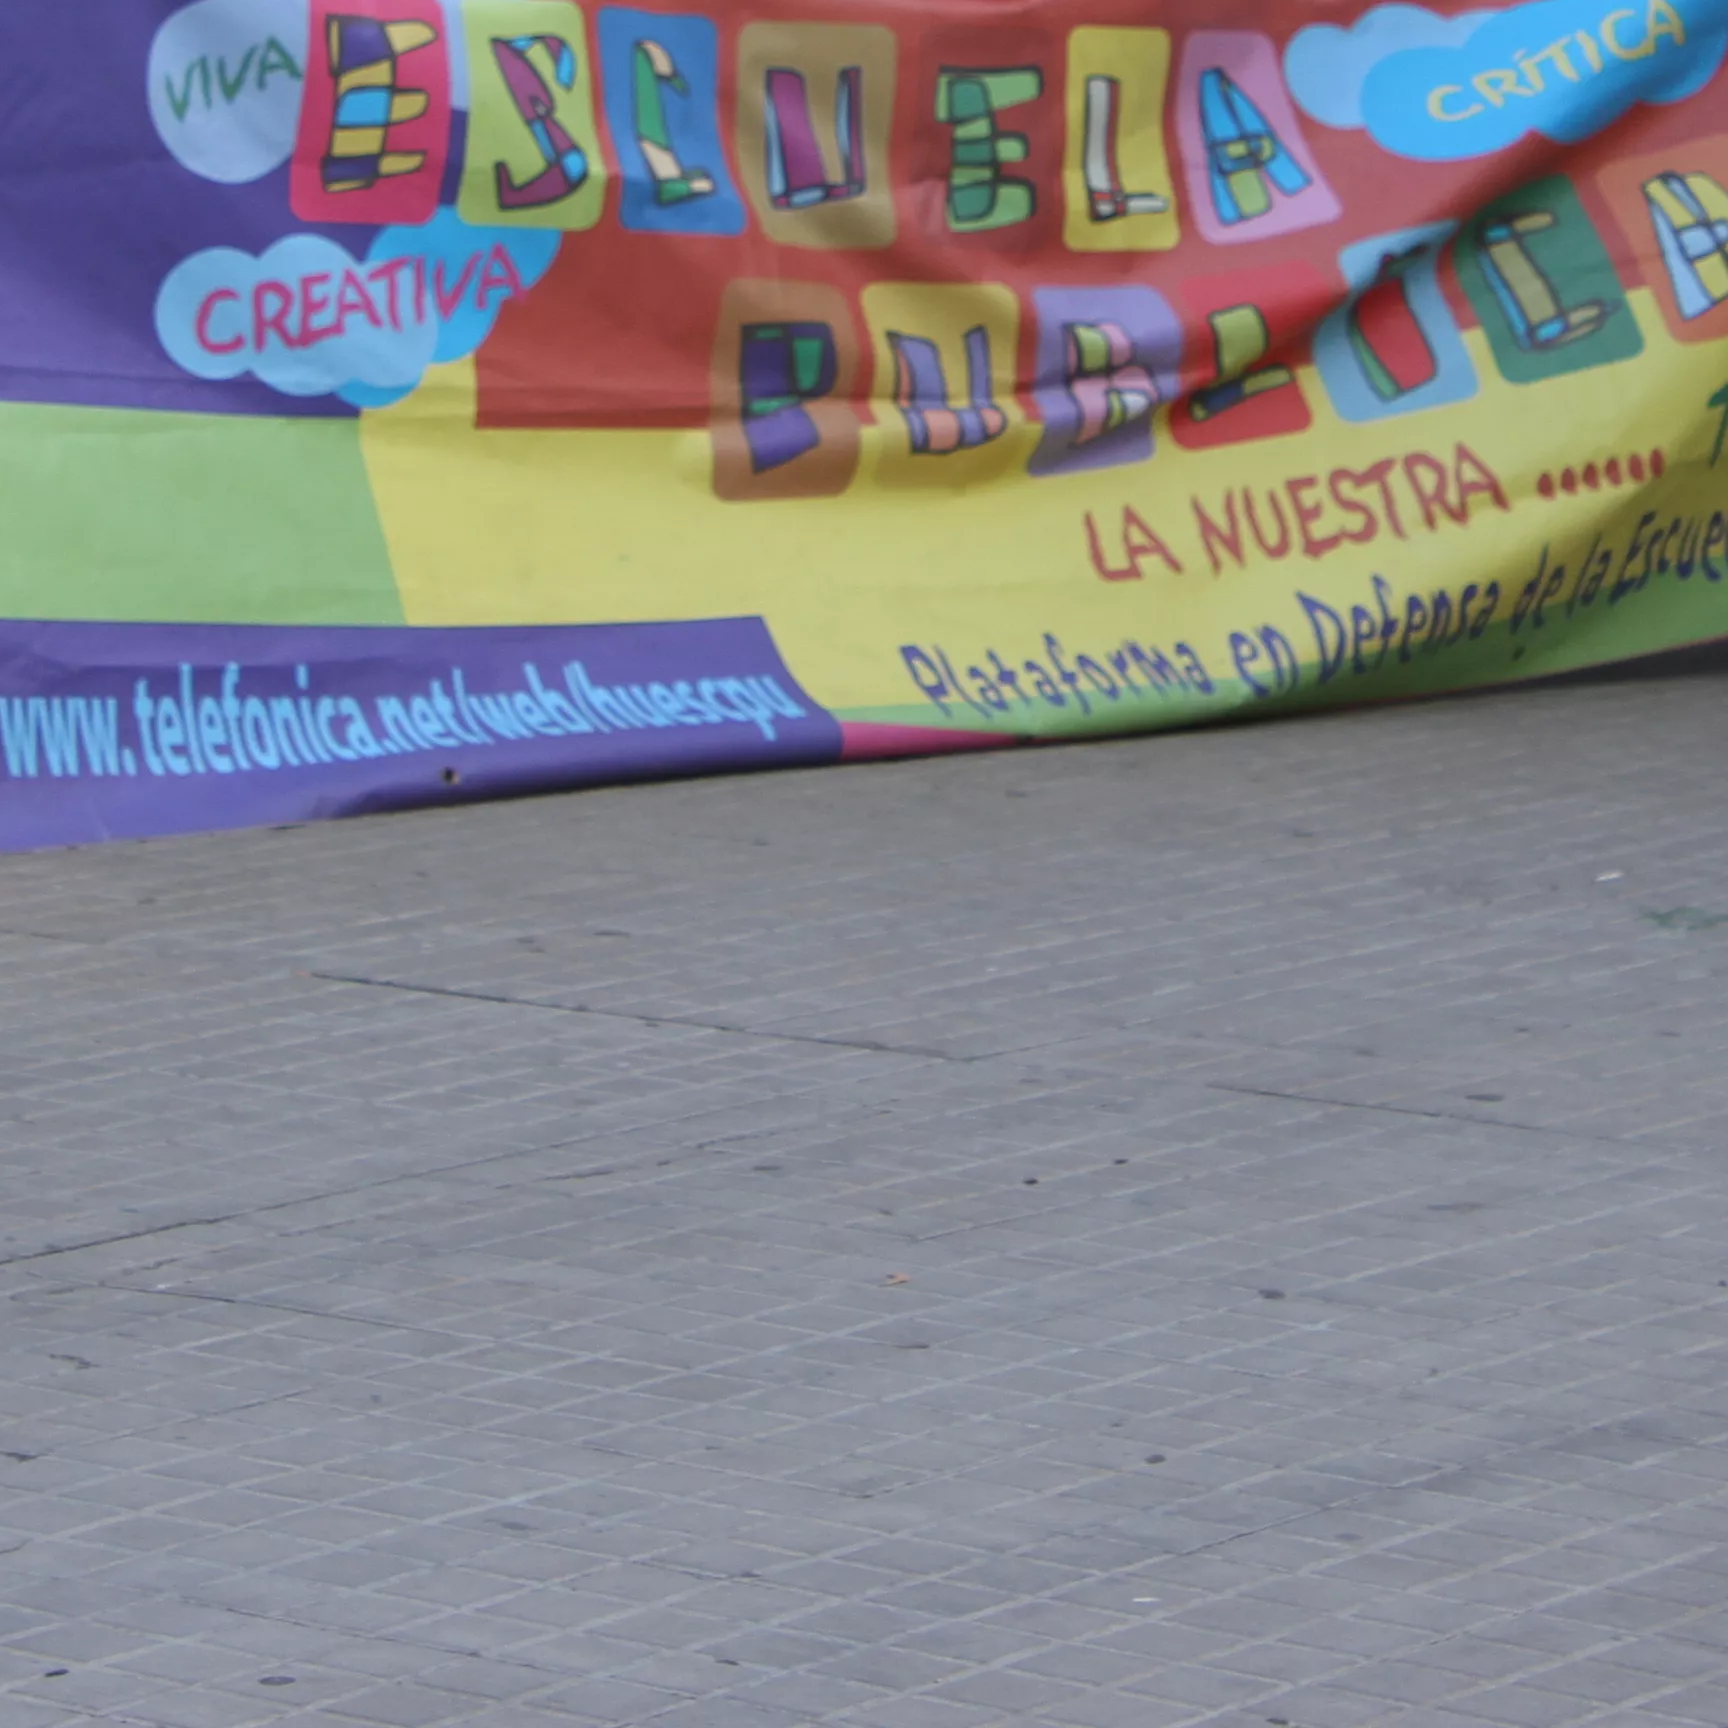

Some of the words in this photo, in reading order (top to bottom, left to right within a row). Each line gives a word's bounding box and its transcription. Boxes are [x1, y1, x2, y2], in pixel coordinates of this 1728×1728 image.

[165, 35, 305, 122] VIVA
[318, 12, 1315, 235] ESCUELA
[195, 242, 528, 355] CREATIVA
[1083, 504, 1184, 582] LA
[1190, 442, 1512, 578] NUESTRA
[898, 631, 1216, 719] Plataforma
[1228, 624, 1300, 700] en
[1295, 573, 1500, 686] Defensa
[1510, 543, 1564, 635] de
[1567, 533, 1613, 618] la
